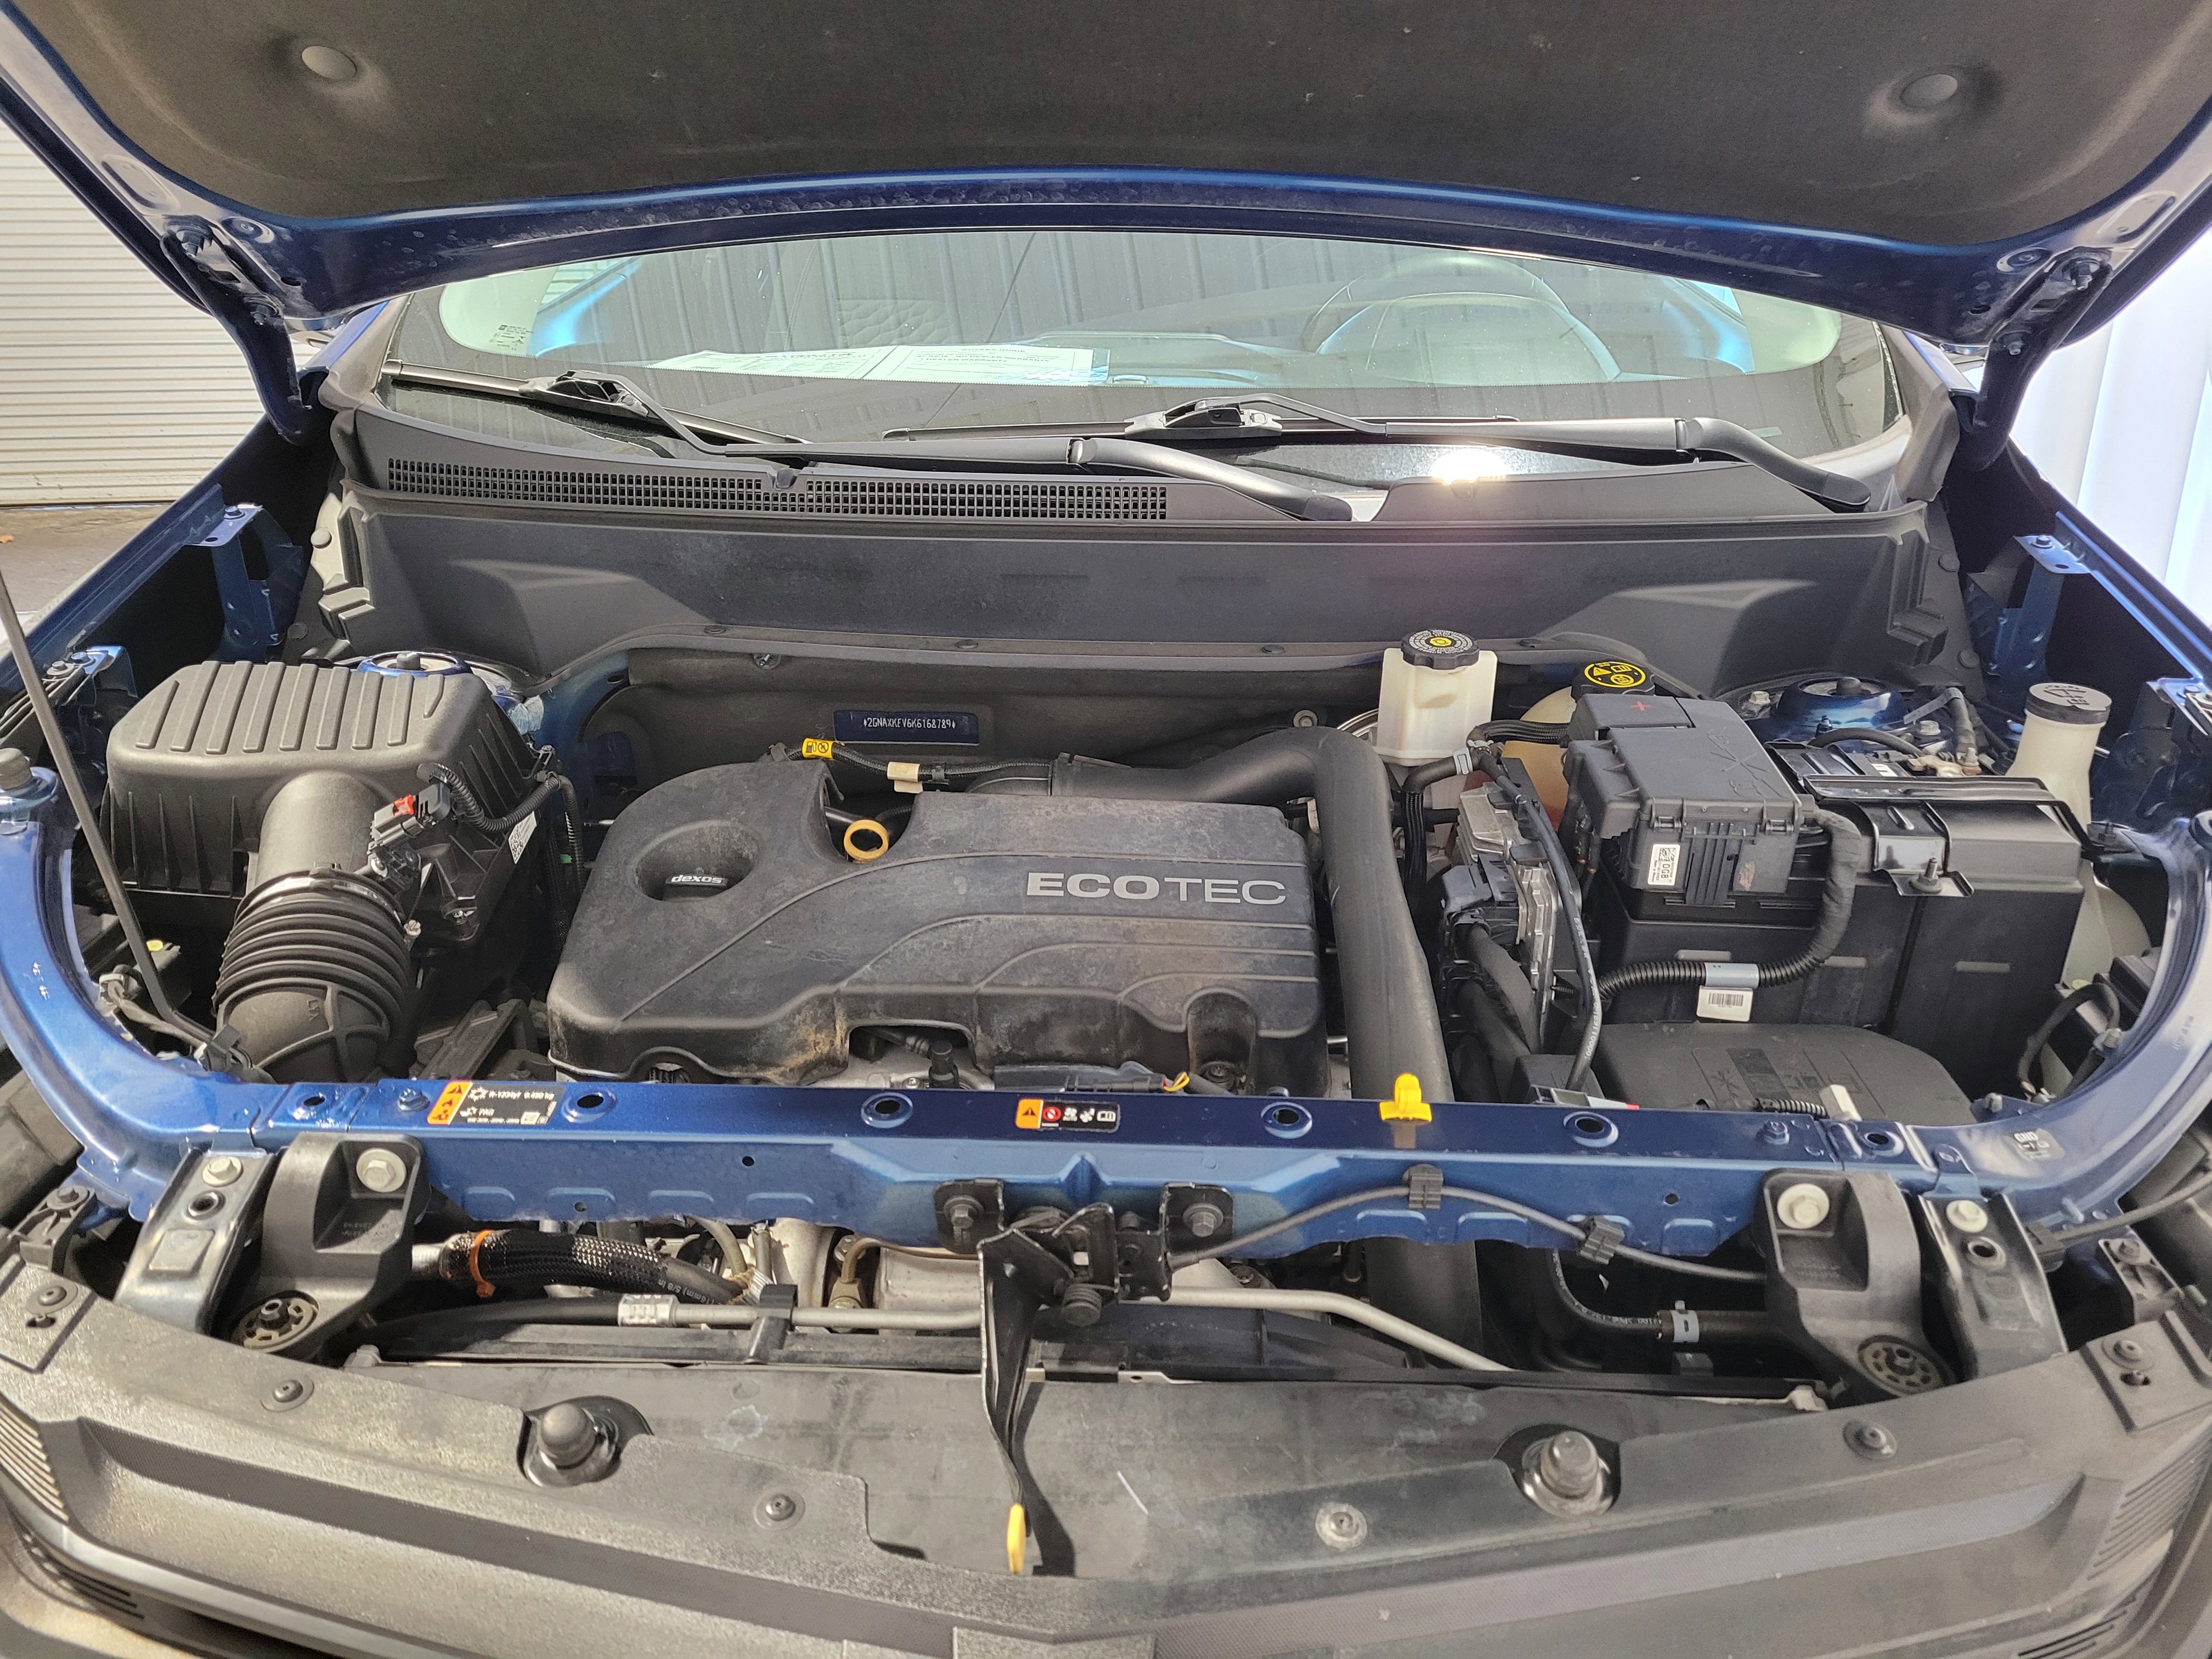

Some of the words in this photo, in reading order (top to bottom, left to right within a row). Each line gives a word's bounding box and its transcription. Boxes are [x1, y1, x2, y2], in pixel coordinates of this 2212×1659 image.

[671, 874, 723, 884] dexos
[1026, 871, 1286, 905] ECOTEC
[2013, 1131, 2039, 1143] GND
